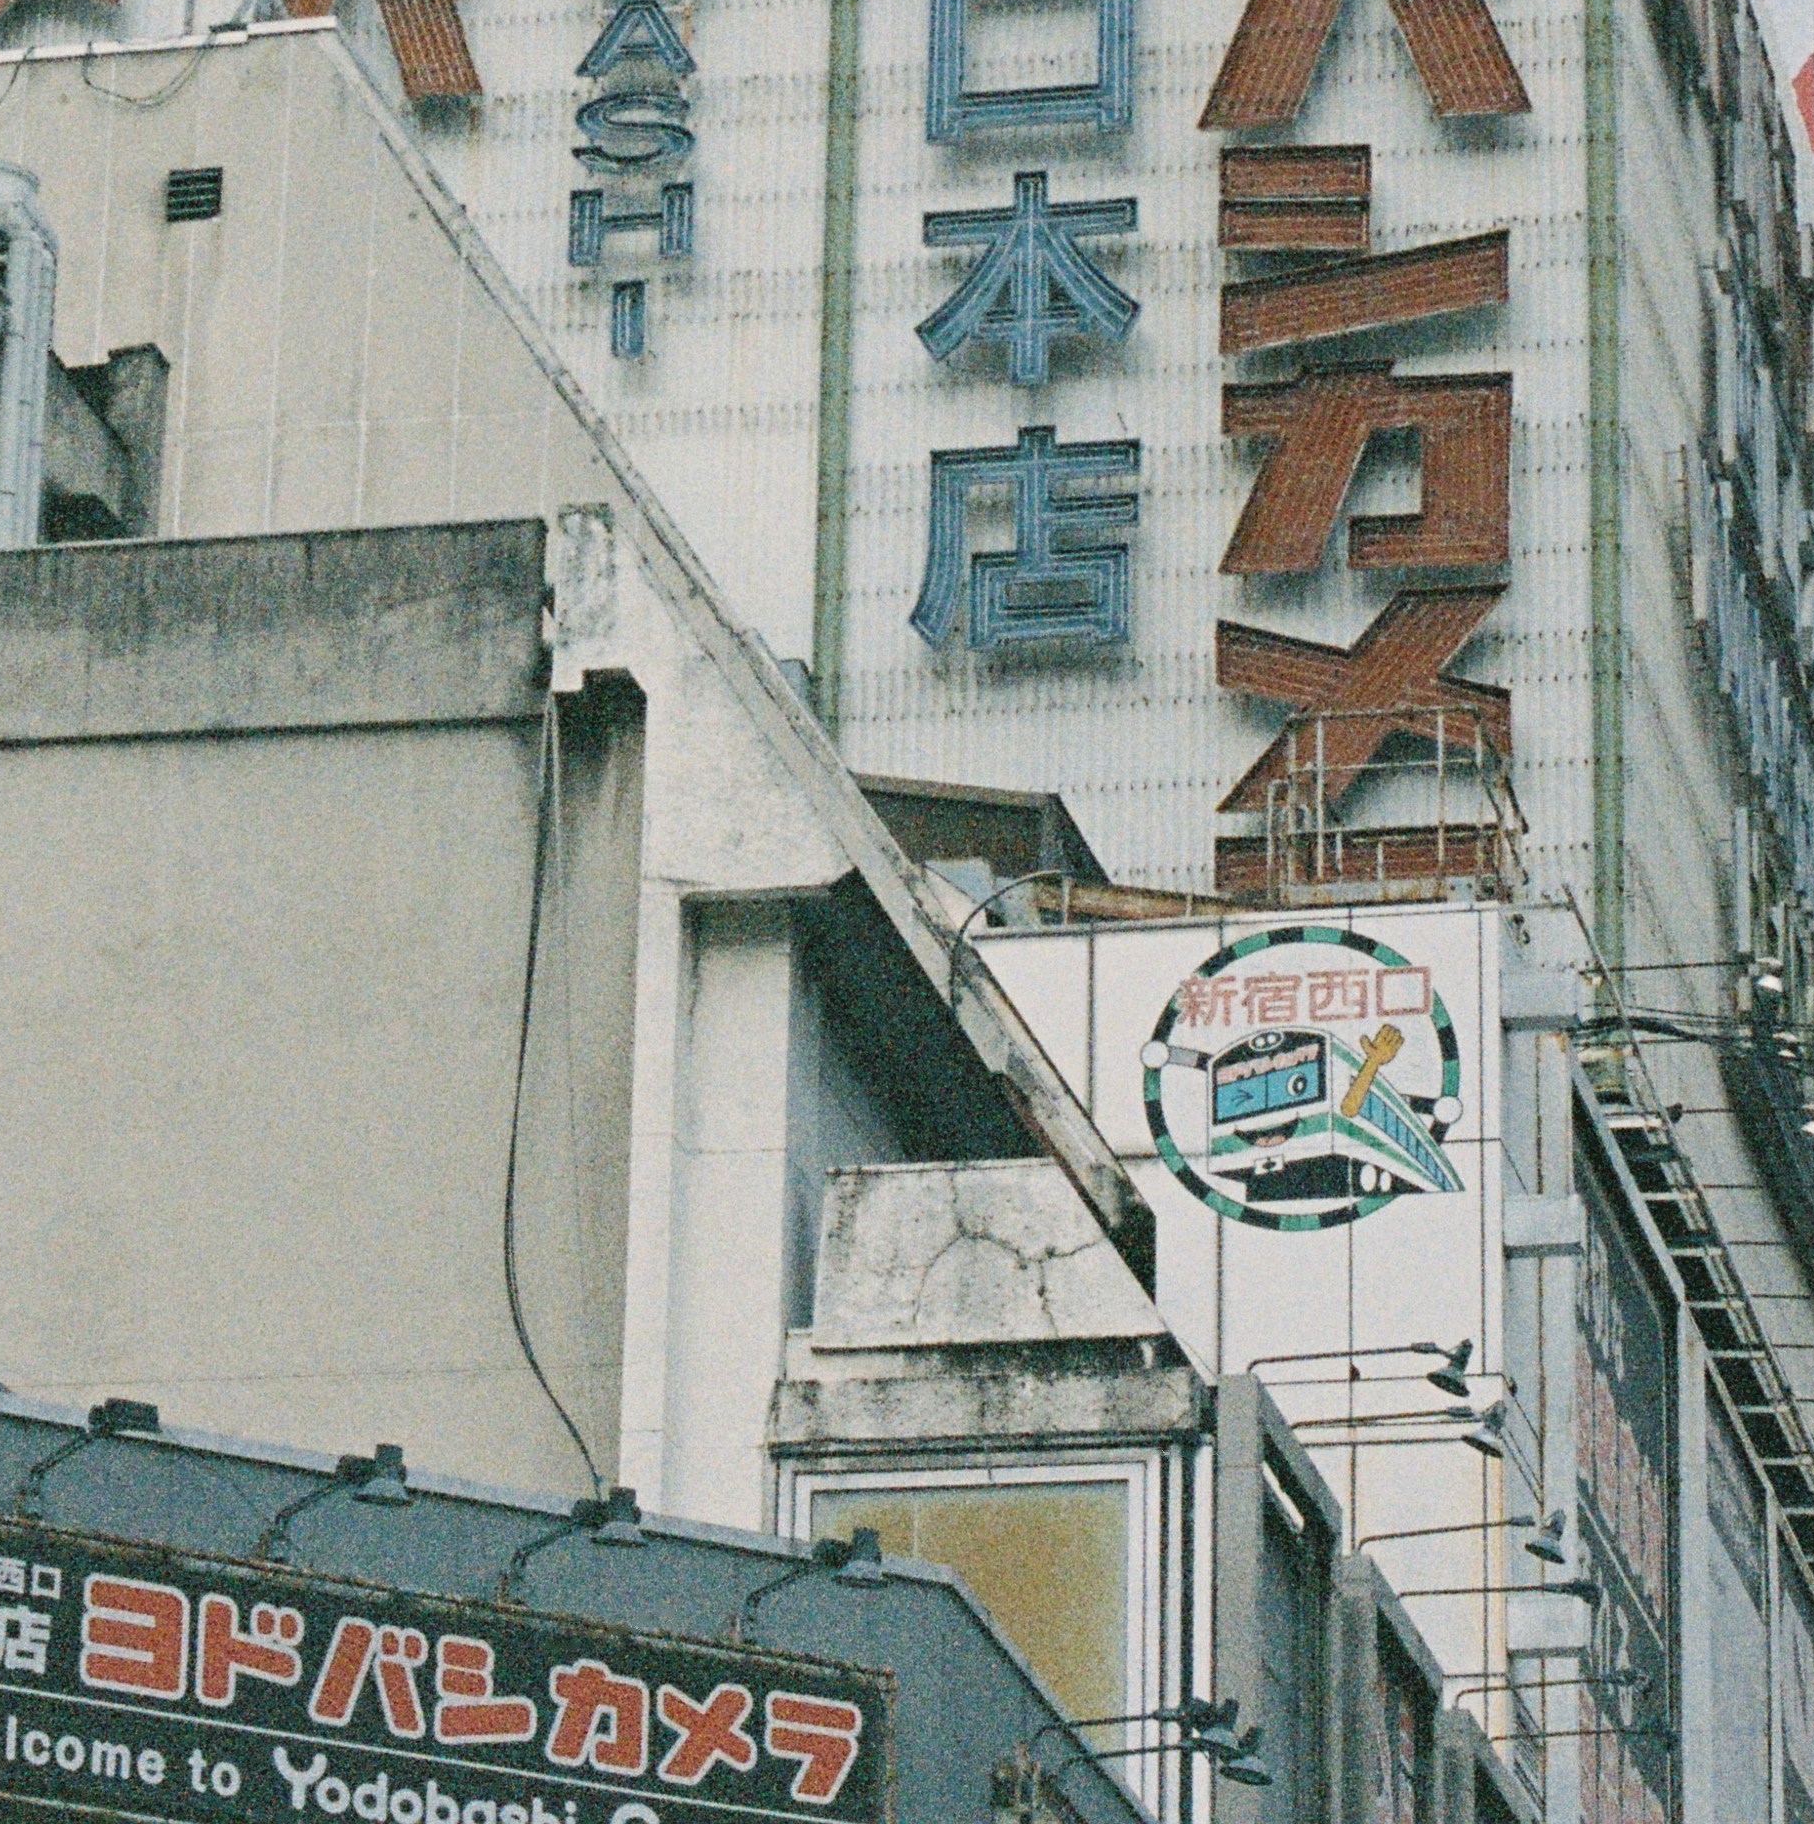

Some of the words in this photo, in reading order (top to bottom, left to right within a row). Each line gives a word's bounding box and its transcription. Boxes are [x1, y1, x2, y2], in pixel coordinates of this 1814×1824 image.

[1175, 965, 1432, 1029] 新宿西口
[79, 1572, 862, 1805] ヨドバシカメラ
[187, 1747, 242, 1798] to
